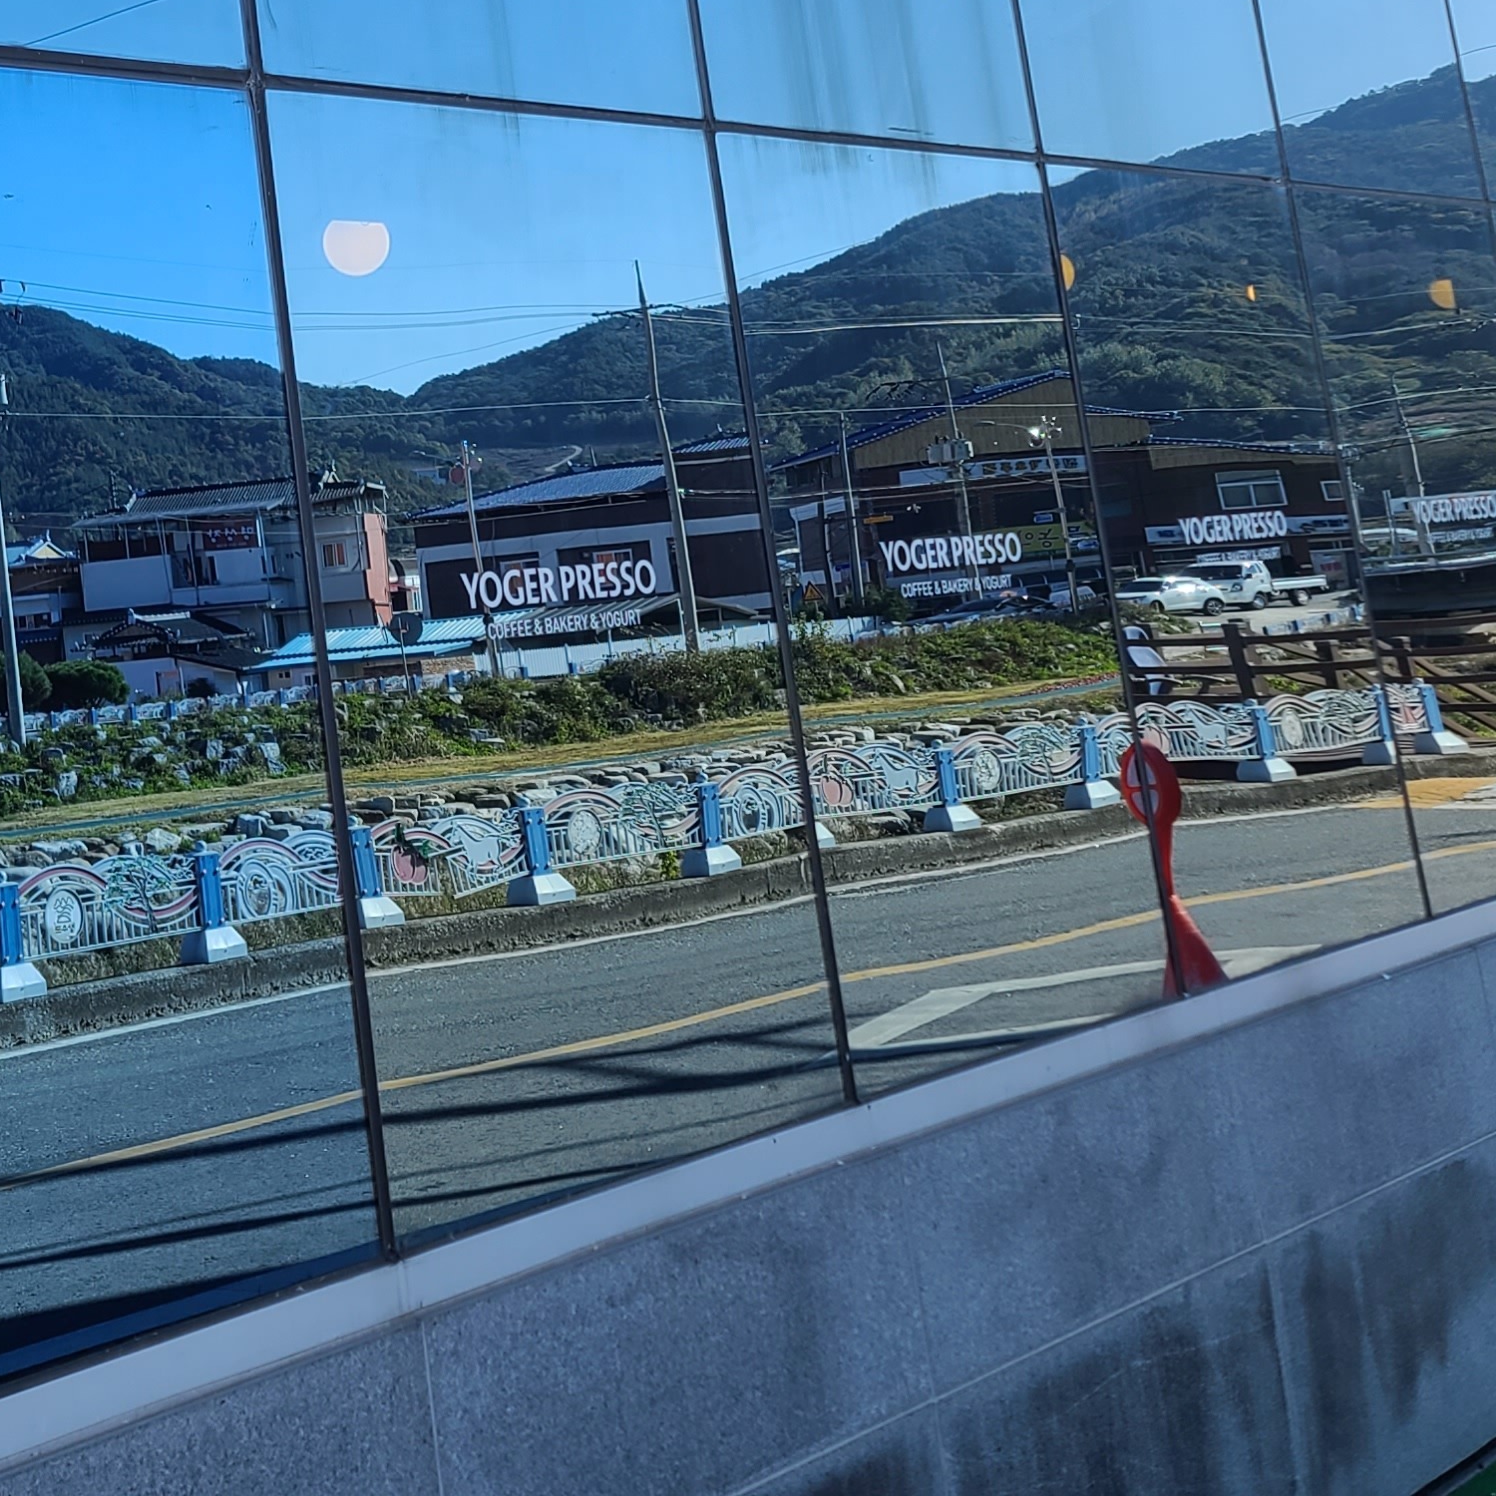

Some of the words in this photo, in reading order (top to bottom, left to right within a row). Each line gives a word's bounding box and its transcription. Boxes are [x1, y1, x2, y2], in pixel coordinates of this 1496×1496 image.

[1177, 514, 1234, 545] YOGER
[1231, 510, 1287, 540] PRESSO
[1412, 499, 1455, 524] YOGER
[880, 535, 954, 572] YOGER
[953, 532, 1022, 566] PRESSO
[460, 566, 558, 609] YOGER
[559, 559, 656, 604] PRESSO
[901, 581, 934, 598] COFFEE
[487, 618, 532, 640] COFFEE
[533, 617, 543, 635] &
[544, 613, 588, 634] BAKERY
[590, 613, 600, 630] &
[599, 609, 642, 629] YOGURT
